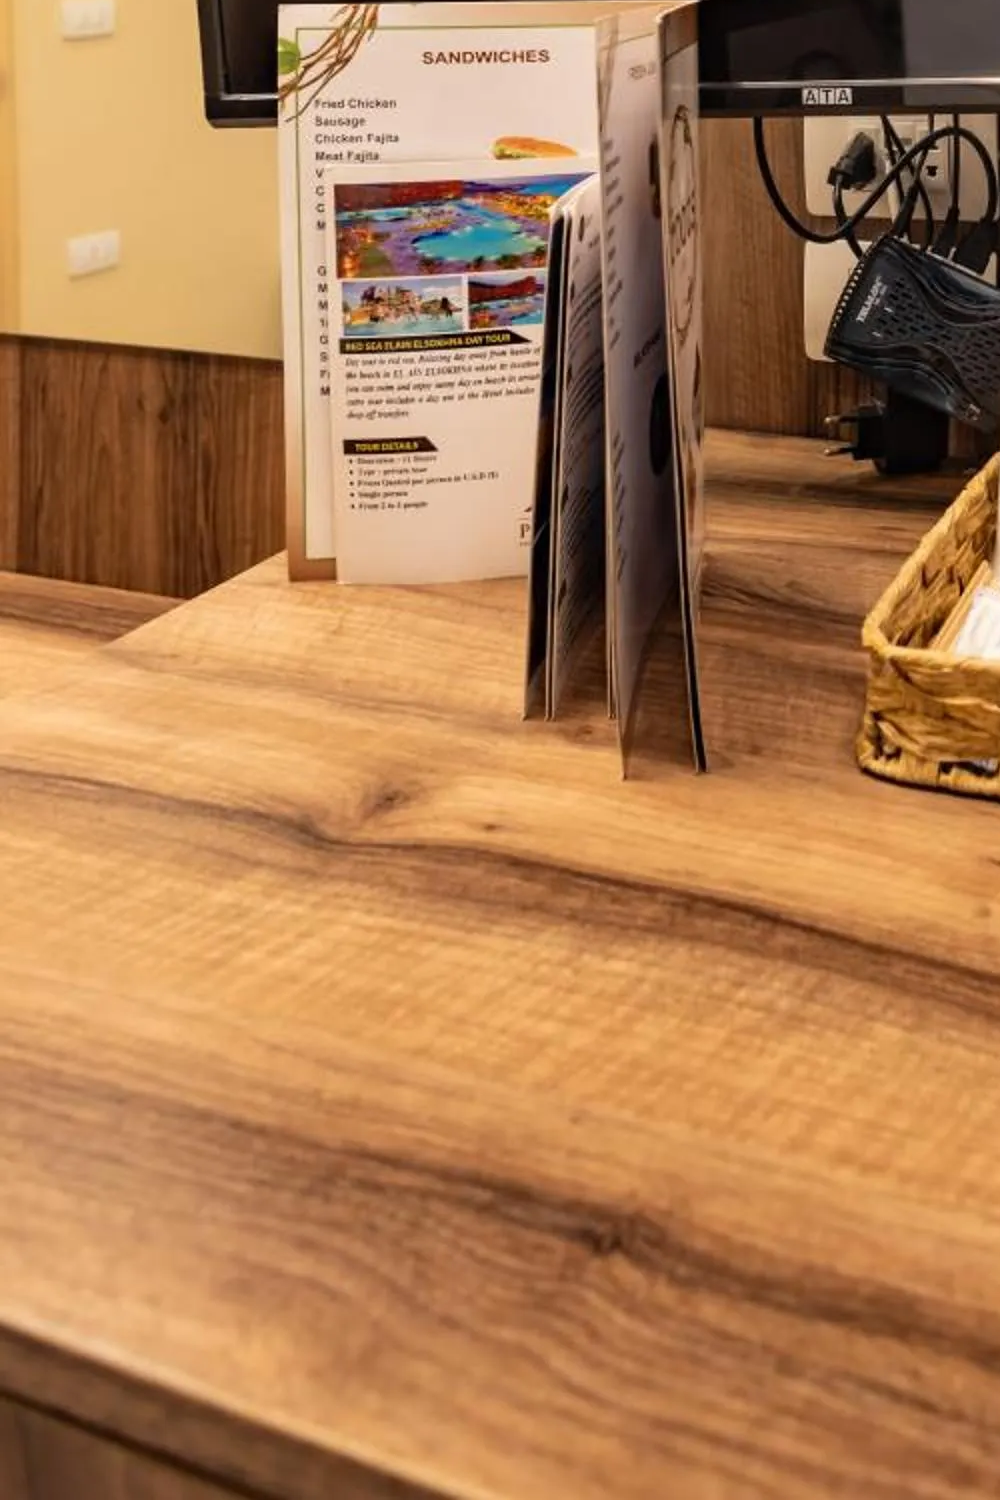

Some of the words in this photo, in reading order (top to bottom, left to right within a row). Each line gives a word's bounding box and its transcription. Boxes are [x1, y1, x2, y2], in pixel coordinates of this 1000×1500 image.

[422, 49, 550, 65] SANDWICHES
[804, 88, 850, 104] ATA
[314, 98, 345, 109] Fried
[348, 98, 397, 109] Chicken
[315, 115, 366, 128] Sausage
[315, 132, 363, 144] Chicken
[367, 132, 400, 145] Fajita
[315, 150, 343, 161] Meat
[347, 150, 380, 163] Fajita
[465, 336, 484, 345] DAY
[485, 333, 511, 342] TOUR
[355, 443, 380, 453] TOUR
